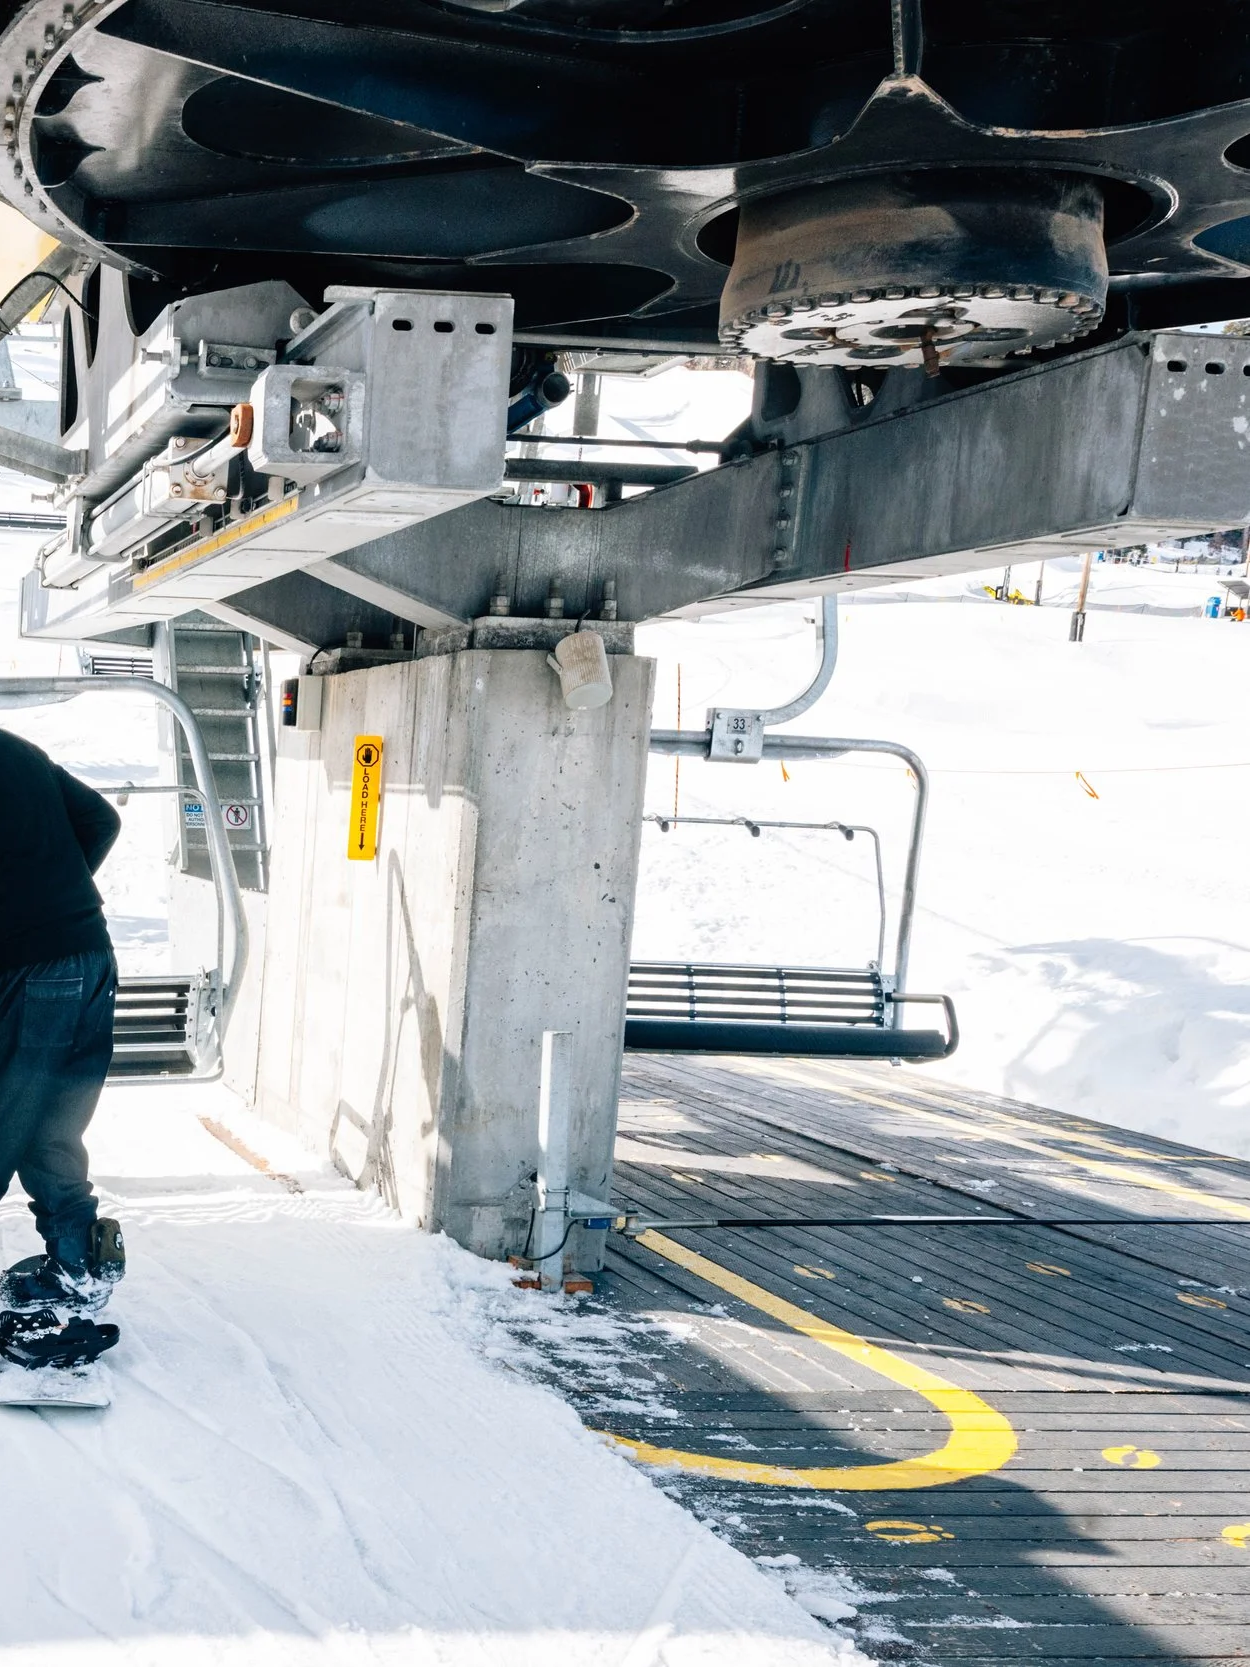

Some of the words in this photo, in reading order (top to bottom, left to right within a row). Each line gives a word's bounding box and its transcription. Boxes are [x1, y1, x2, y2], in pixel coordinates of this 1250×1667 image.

[733, 718, 746, 730] 33
[361, 768, 370, 799] LOAD
[359, 801, 369, 832] HERE
